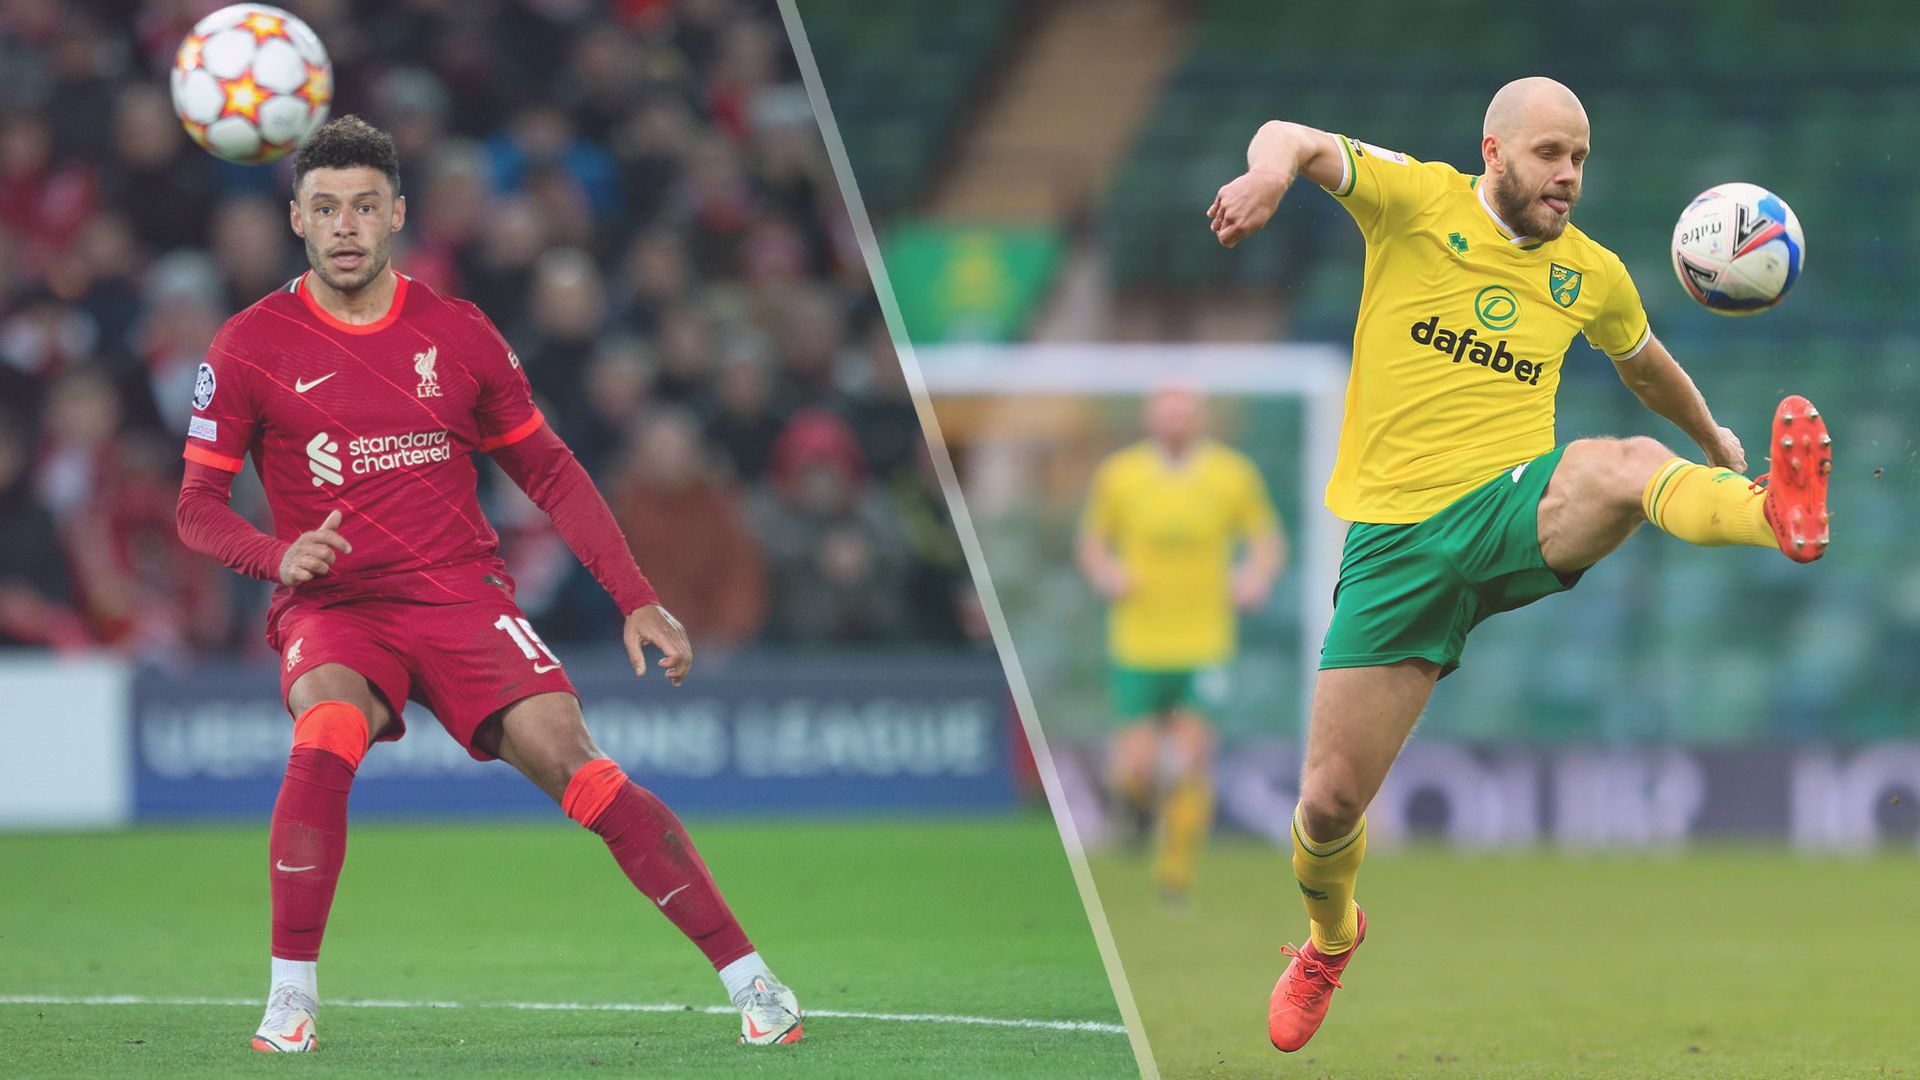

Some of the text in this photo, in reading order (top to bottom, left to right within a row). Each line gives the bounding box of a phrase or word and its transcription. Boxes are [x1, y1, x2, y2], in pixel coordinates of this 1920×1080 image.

[1680, 221, 1722, 245] mitre
[1410, 316, 1544, 386] dafabet
[348, 430, 449, 456] standard
[351, 441, 450, 474] chartered
